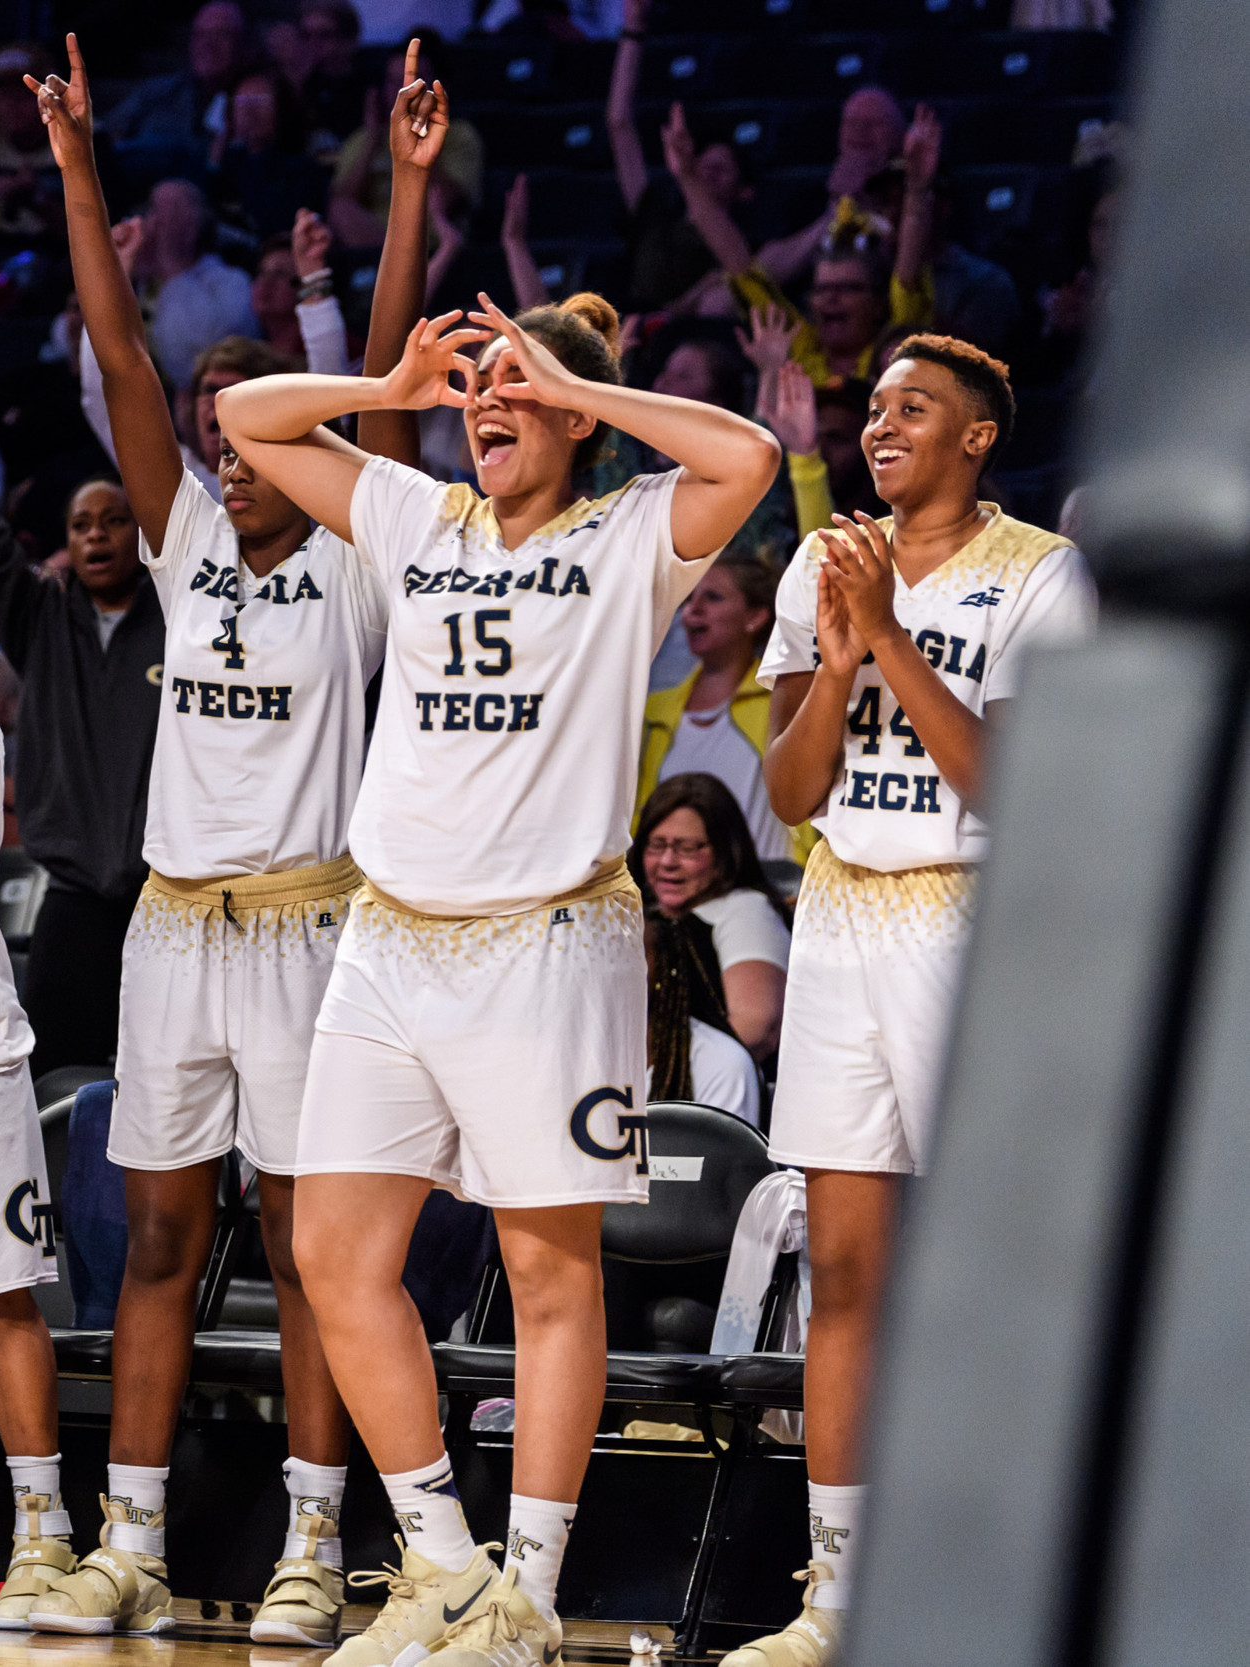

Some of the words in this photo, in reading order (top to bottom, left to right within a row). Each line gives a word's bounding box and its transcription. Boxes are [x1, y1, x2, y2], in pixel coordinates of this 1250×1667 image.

[212, 614, 246, 671] 4
[442, 607, 514, 678] 15
[172, 676, 292, 721] TECH
[415, 692, 544, 732] TECH
[848, 685, 927, 759] 44
[839, 768, 943, 815] ECH
